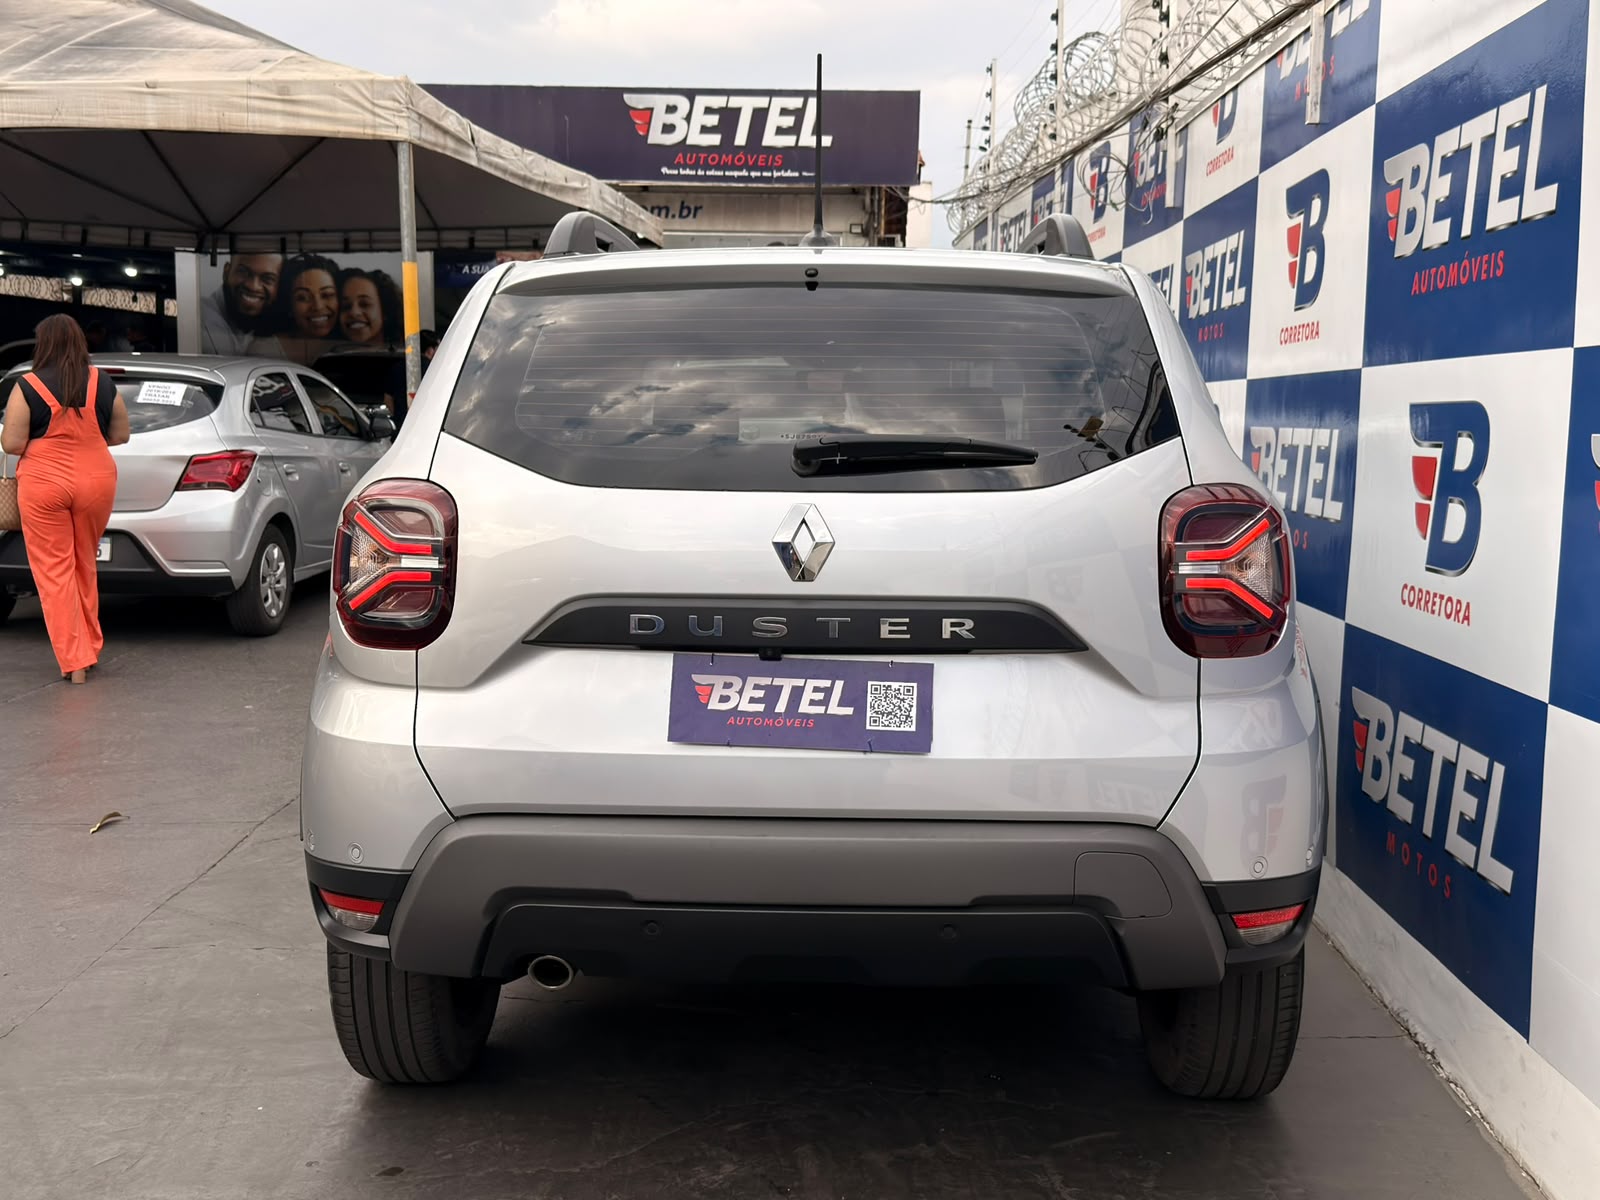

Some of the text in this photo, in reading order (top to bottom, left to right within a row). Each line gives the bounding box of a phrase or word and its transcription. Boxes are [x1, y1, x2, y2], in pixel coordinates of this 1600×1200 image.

[623, 92, 833, 148] BETEL
[674, 152, 784, 167] AUTOMÓVEIS
[1384, 83, 1559, 258] BETEL
[462, 264, 470, 274] A
[1185, 230, 1247, 320] BETEL
[1410, 250, 1505, 295] AUTOMÓVEIS
[1198, 322, 1225, 342] MOTOS
[1279, 320, 1320, 345] CORRETORA
[1250, 426, 1344, 523] BETEL
[1409, 400, 1491, 577] B
[629, 613, 976, 639] DUSTER
[1401, 583, 1471, 626] CORRETORA
[691, 673, 854, 715] BETEL
[727, 715, 815, 728] AUTOMÓVEIS
[1352, 686, 1514, 896] BETEL
[1386, 831, 1451, 898] MOTOS
